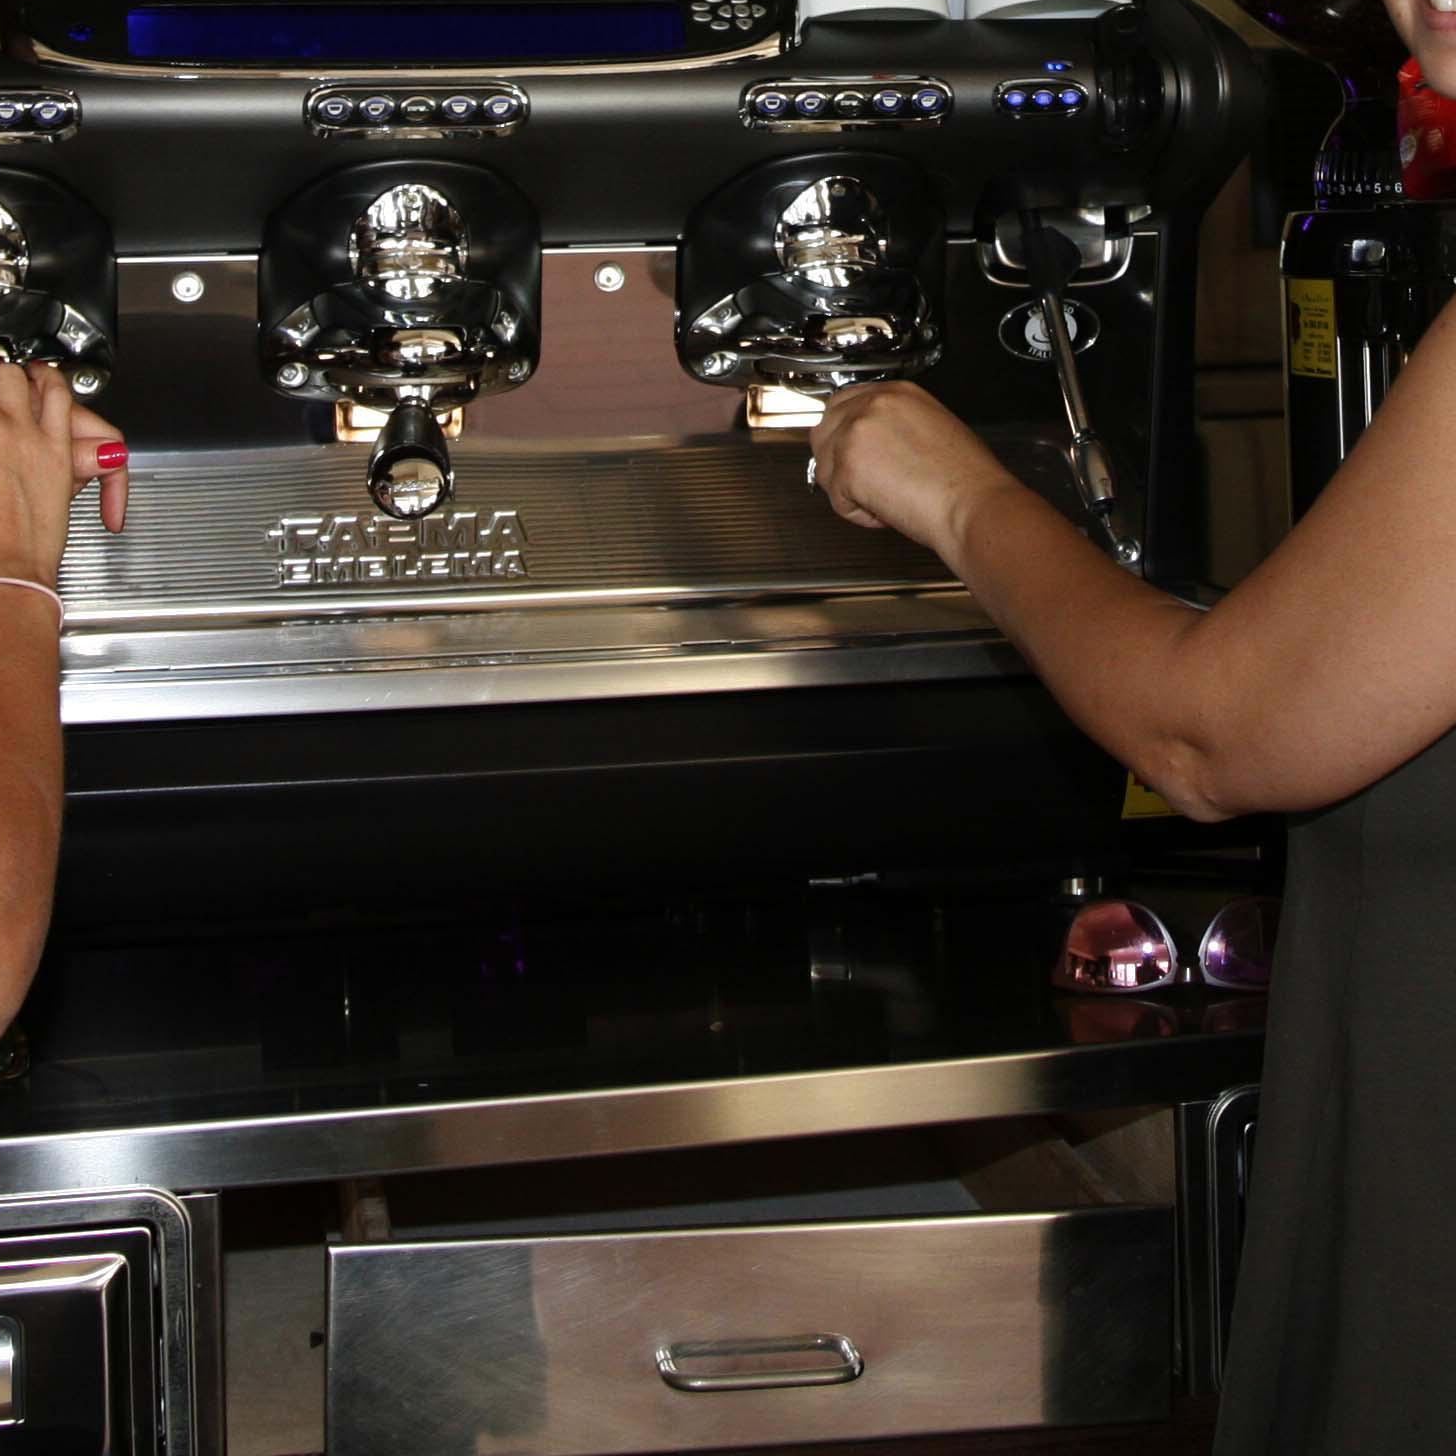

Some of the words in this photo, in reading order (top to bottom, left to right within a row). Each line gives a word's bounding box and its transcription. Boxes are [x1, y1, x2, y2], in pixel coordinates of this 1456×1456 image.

[1354, 182, 1363, 194] 4
[1374, 182, 1383, 194] 5
[1393, 181, 1403, 193] 6
[270, 510, 529, 552] FAEMA
[277, 550, 529, 585] EMBLEMA
